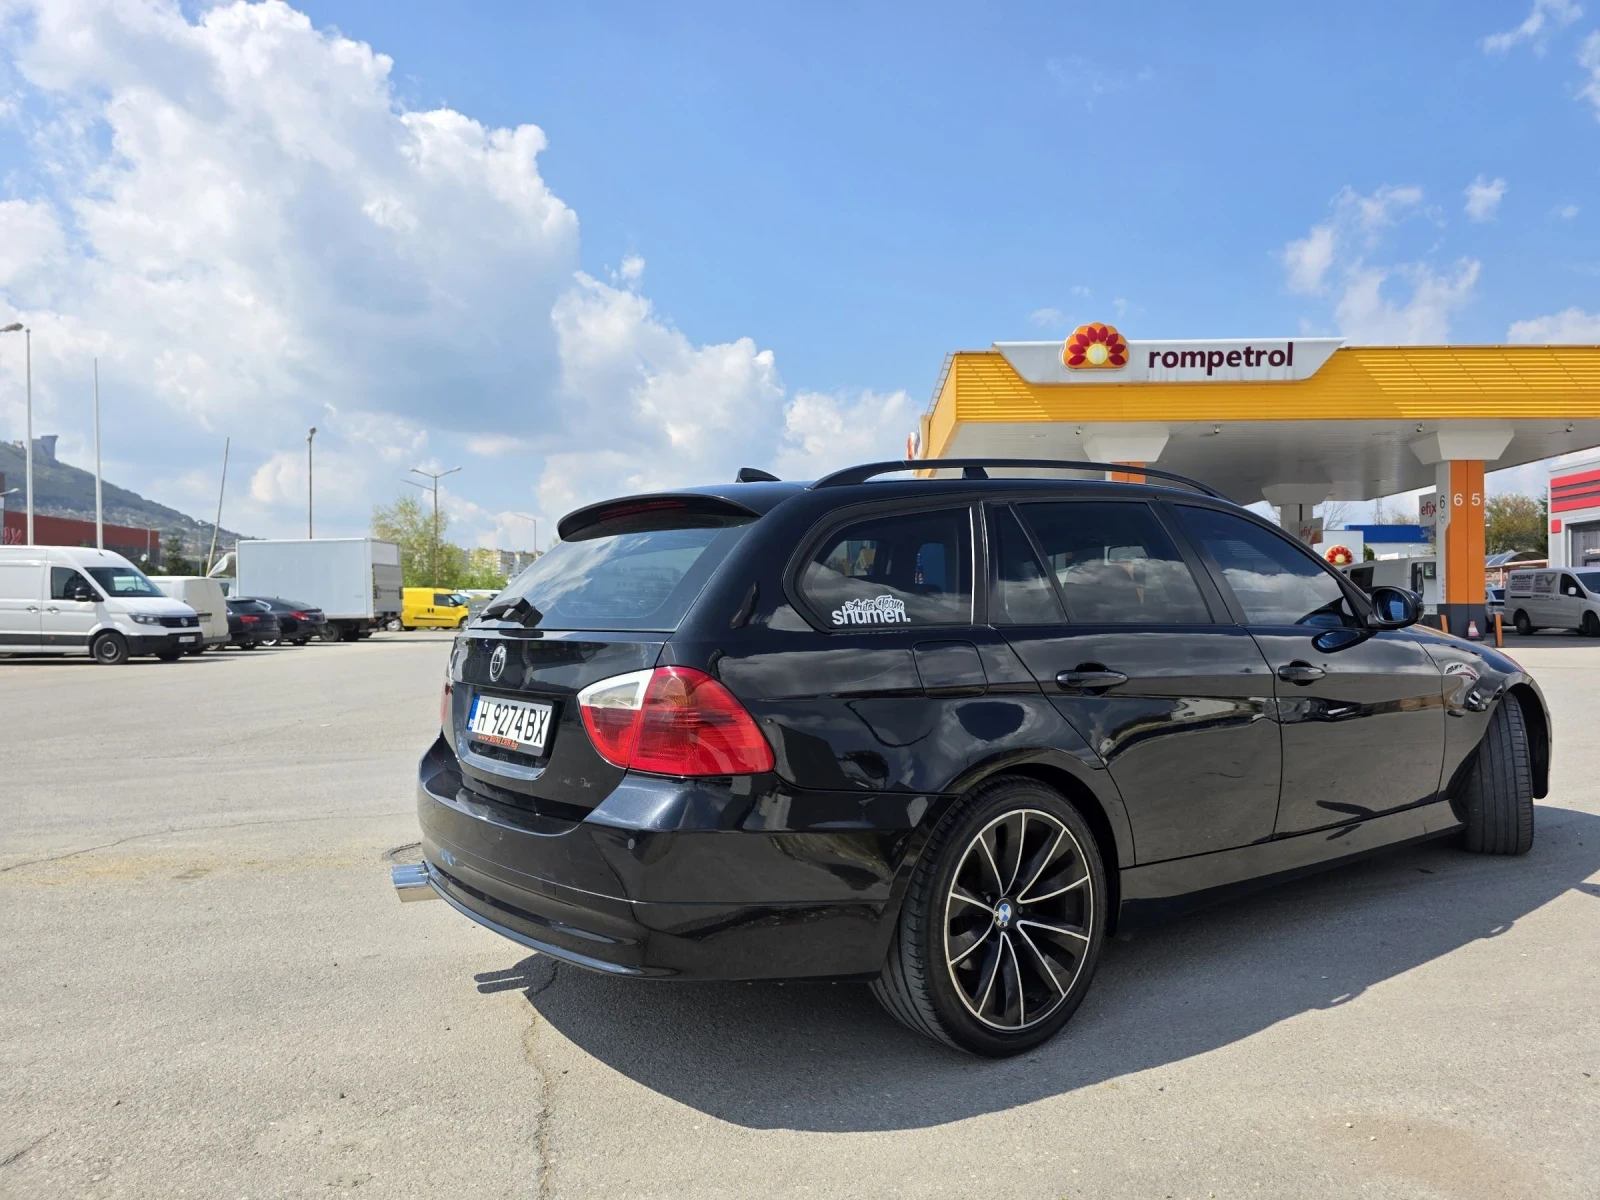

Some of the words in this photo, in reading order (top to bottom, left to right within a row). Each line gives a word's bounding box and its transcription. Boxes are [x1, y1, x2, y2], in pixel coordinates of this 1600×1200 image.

[1149, 342, 1293, 375] rompetrol
[1439, 495, 1446, 509] 6
[1453, 493, 1464, 507] 6
[1471, 493, 1481, 506] 5
[876, 595, 905, 611] Team
